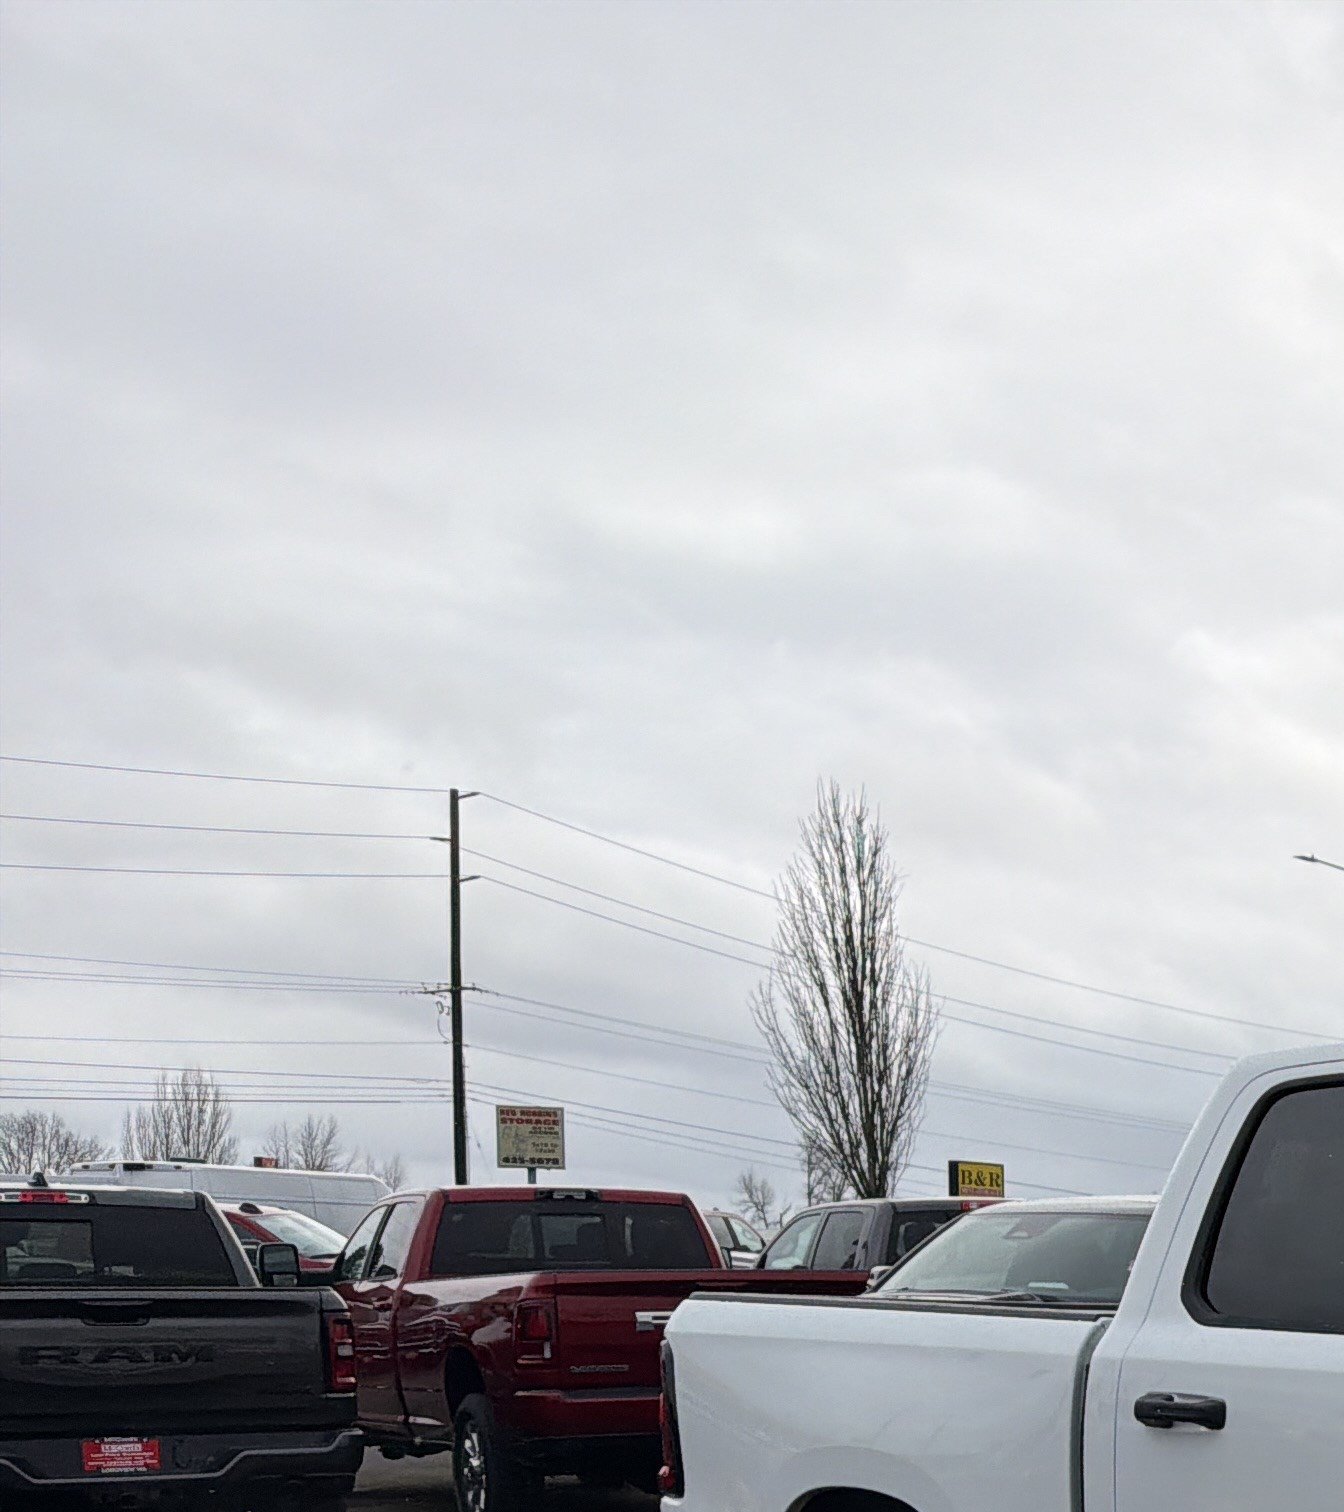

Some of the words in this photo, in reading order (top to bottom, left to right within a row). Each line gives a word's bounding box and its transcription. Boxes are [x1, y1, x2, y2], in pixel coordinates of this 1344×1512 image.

[500, 1117, 560, 1126] STORAGE
[960, 1169, 1001, 1188] B&R
[18, 1345, 215, 1366] RAM
